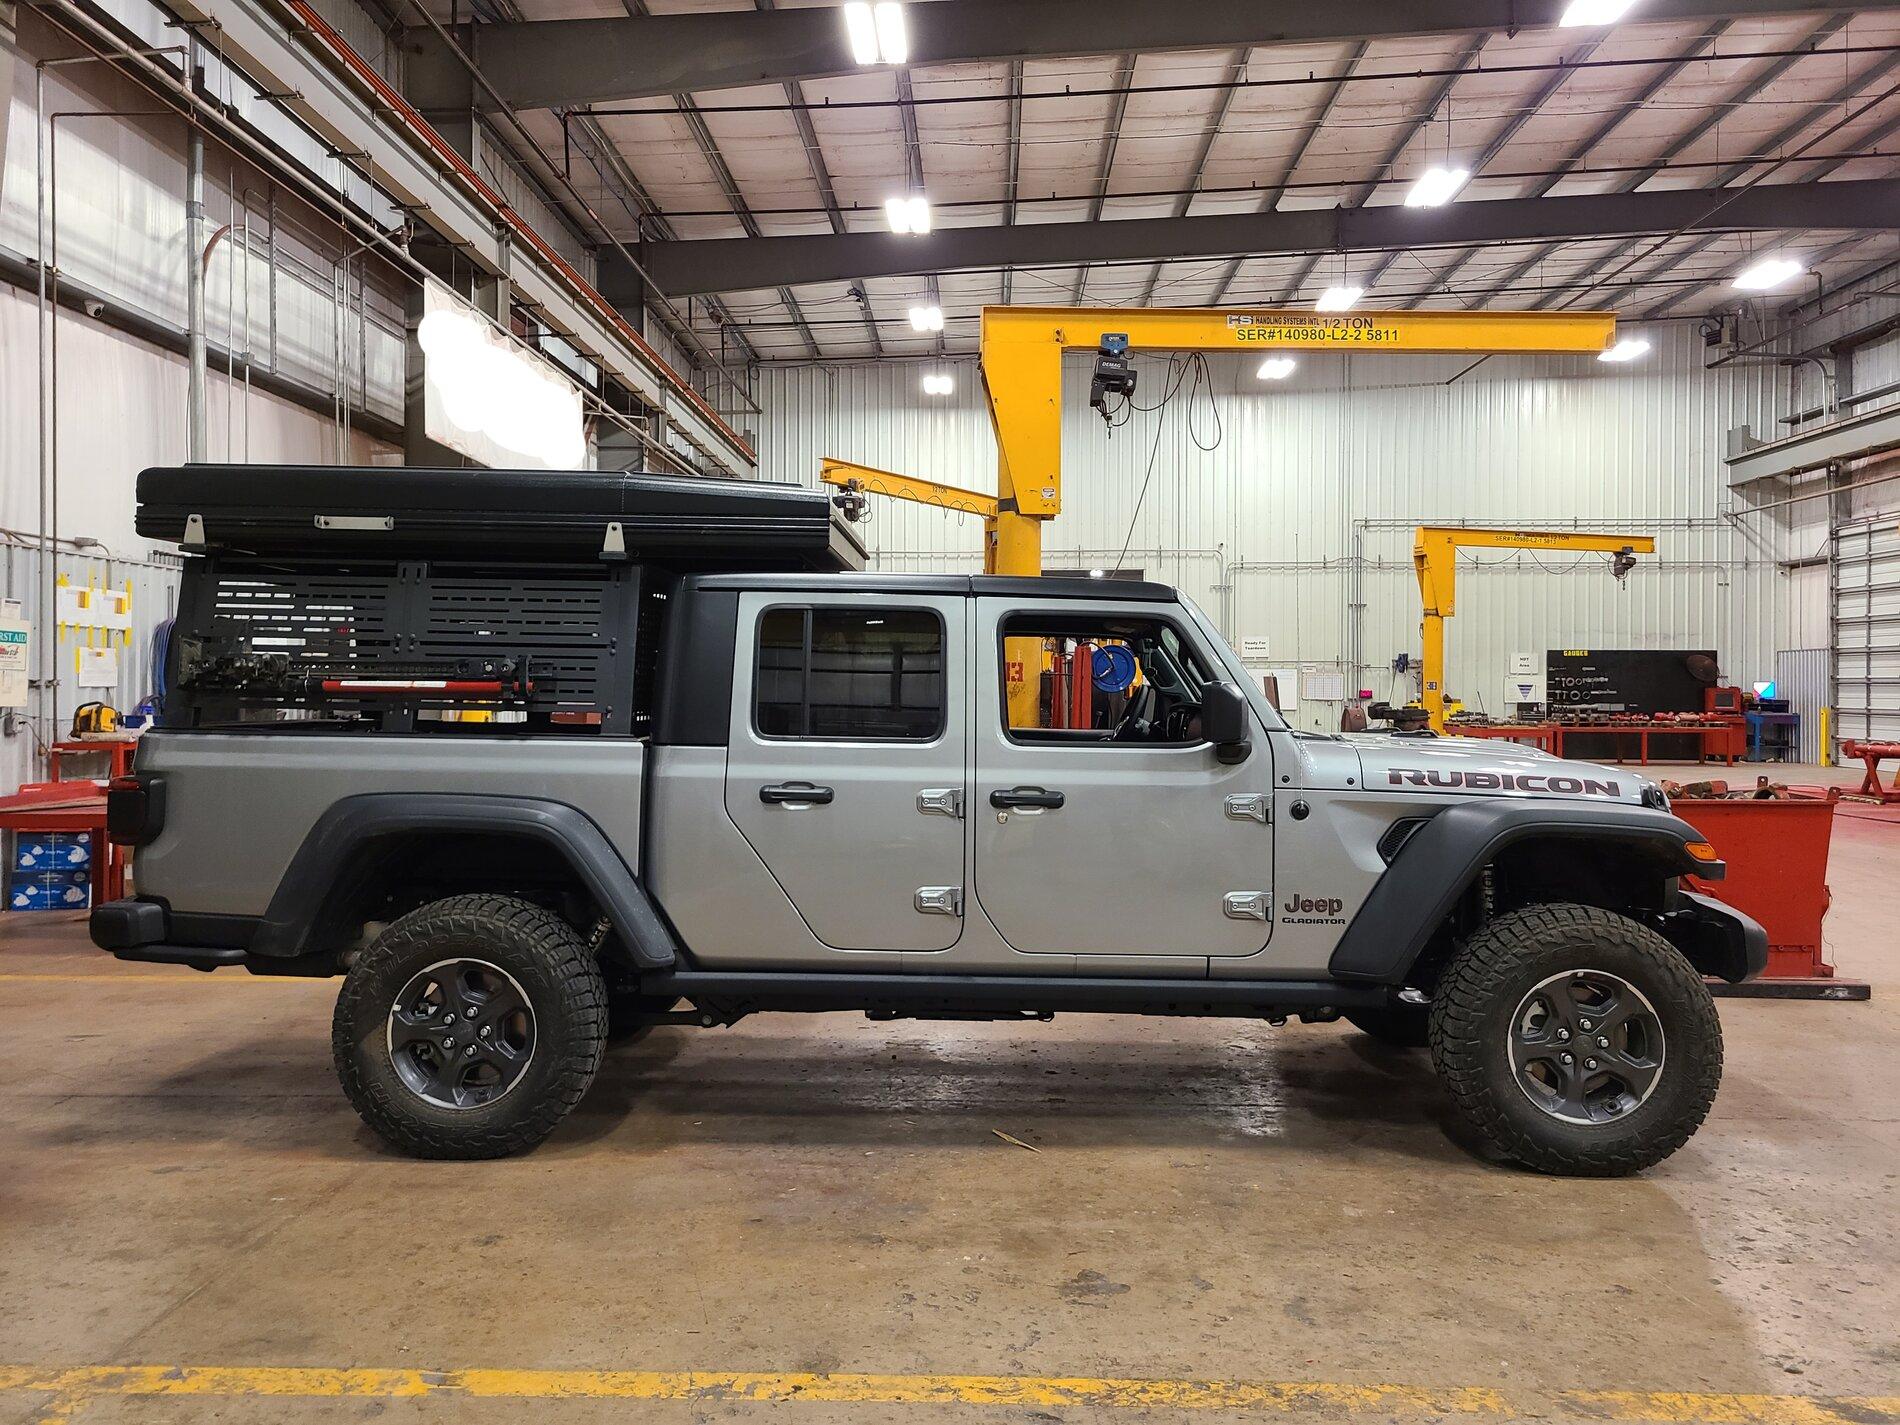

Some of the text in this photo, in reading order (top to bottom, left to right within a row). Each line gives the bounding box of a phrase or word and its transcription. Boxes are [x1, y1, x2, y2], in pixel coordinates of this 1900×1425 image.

[1255, 316, 1282, 325] HANDLING
[1282, 316, 1307, 326] SYSTEMS
[1322, 318, 1340, 329] 1/2
[1345, 318, 1373, 329] TON
[1237, 329, 1398, 341] SER#140980-L2-2 5811
[14, 633, 27, 642] AID
[1388, 768, 1621, 798] RUBICON
[1284, 893, 1343, 916] Jeep
[1281, 917, 1346, 925] GLADIATOR
